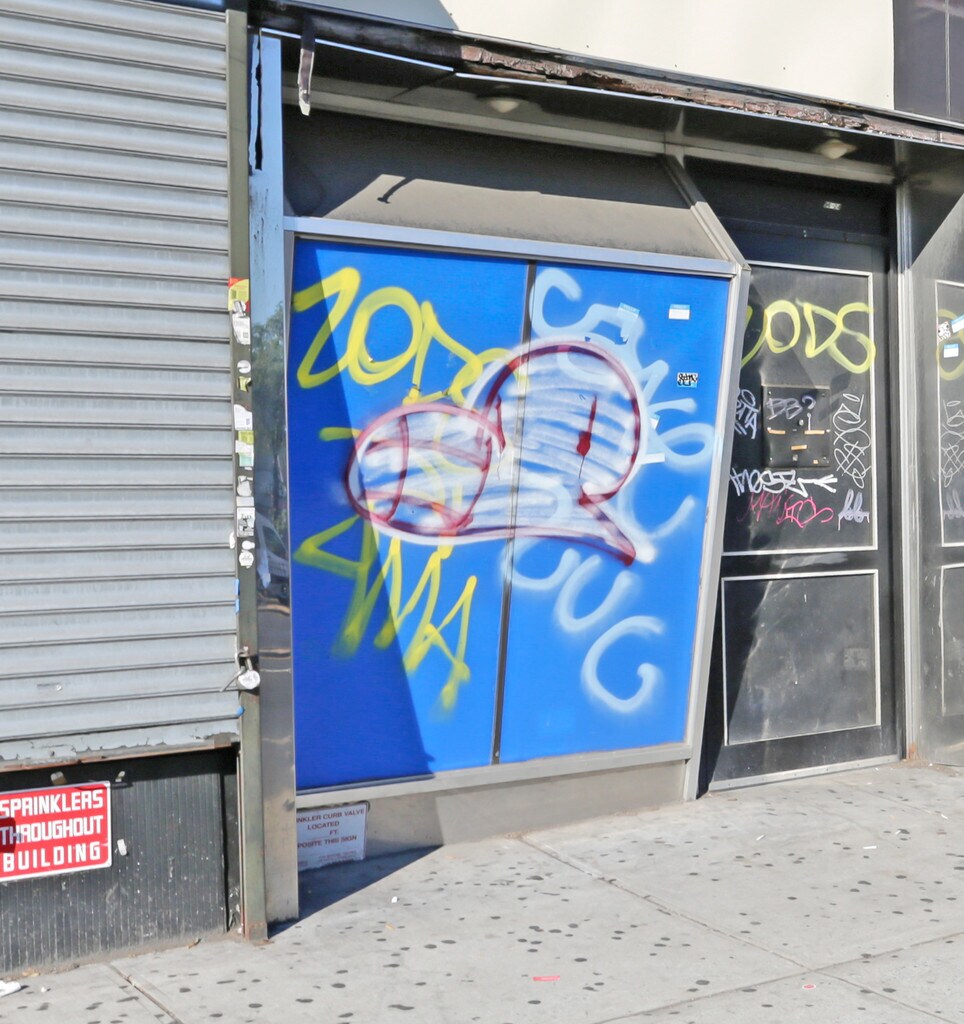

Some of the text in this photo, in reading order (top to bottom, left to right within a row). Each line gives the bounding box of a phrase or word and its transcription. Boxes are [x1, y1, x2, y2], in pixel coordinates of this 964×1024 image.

[0, 789, 104, 818] SPRINKLERS
[0, 815, 104, 845] THROUGHOUT
[307, 821, 340, 830] LOCATED
[340, 835, 357, 843] SIGN
[3, 841, 101, 872] BUILDING
